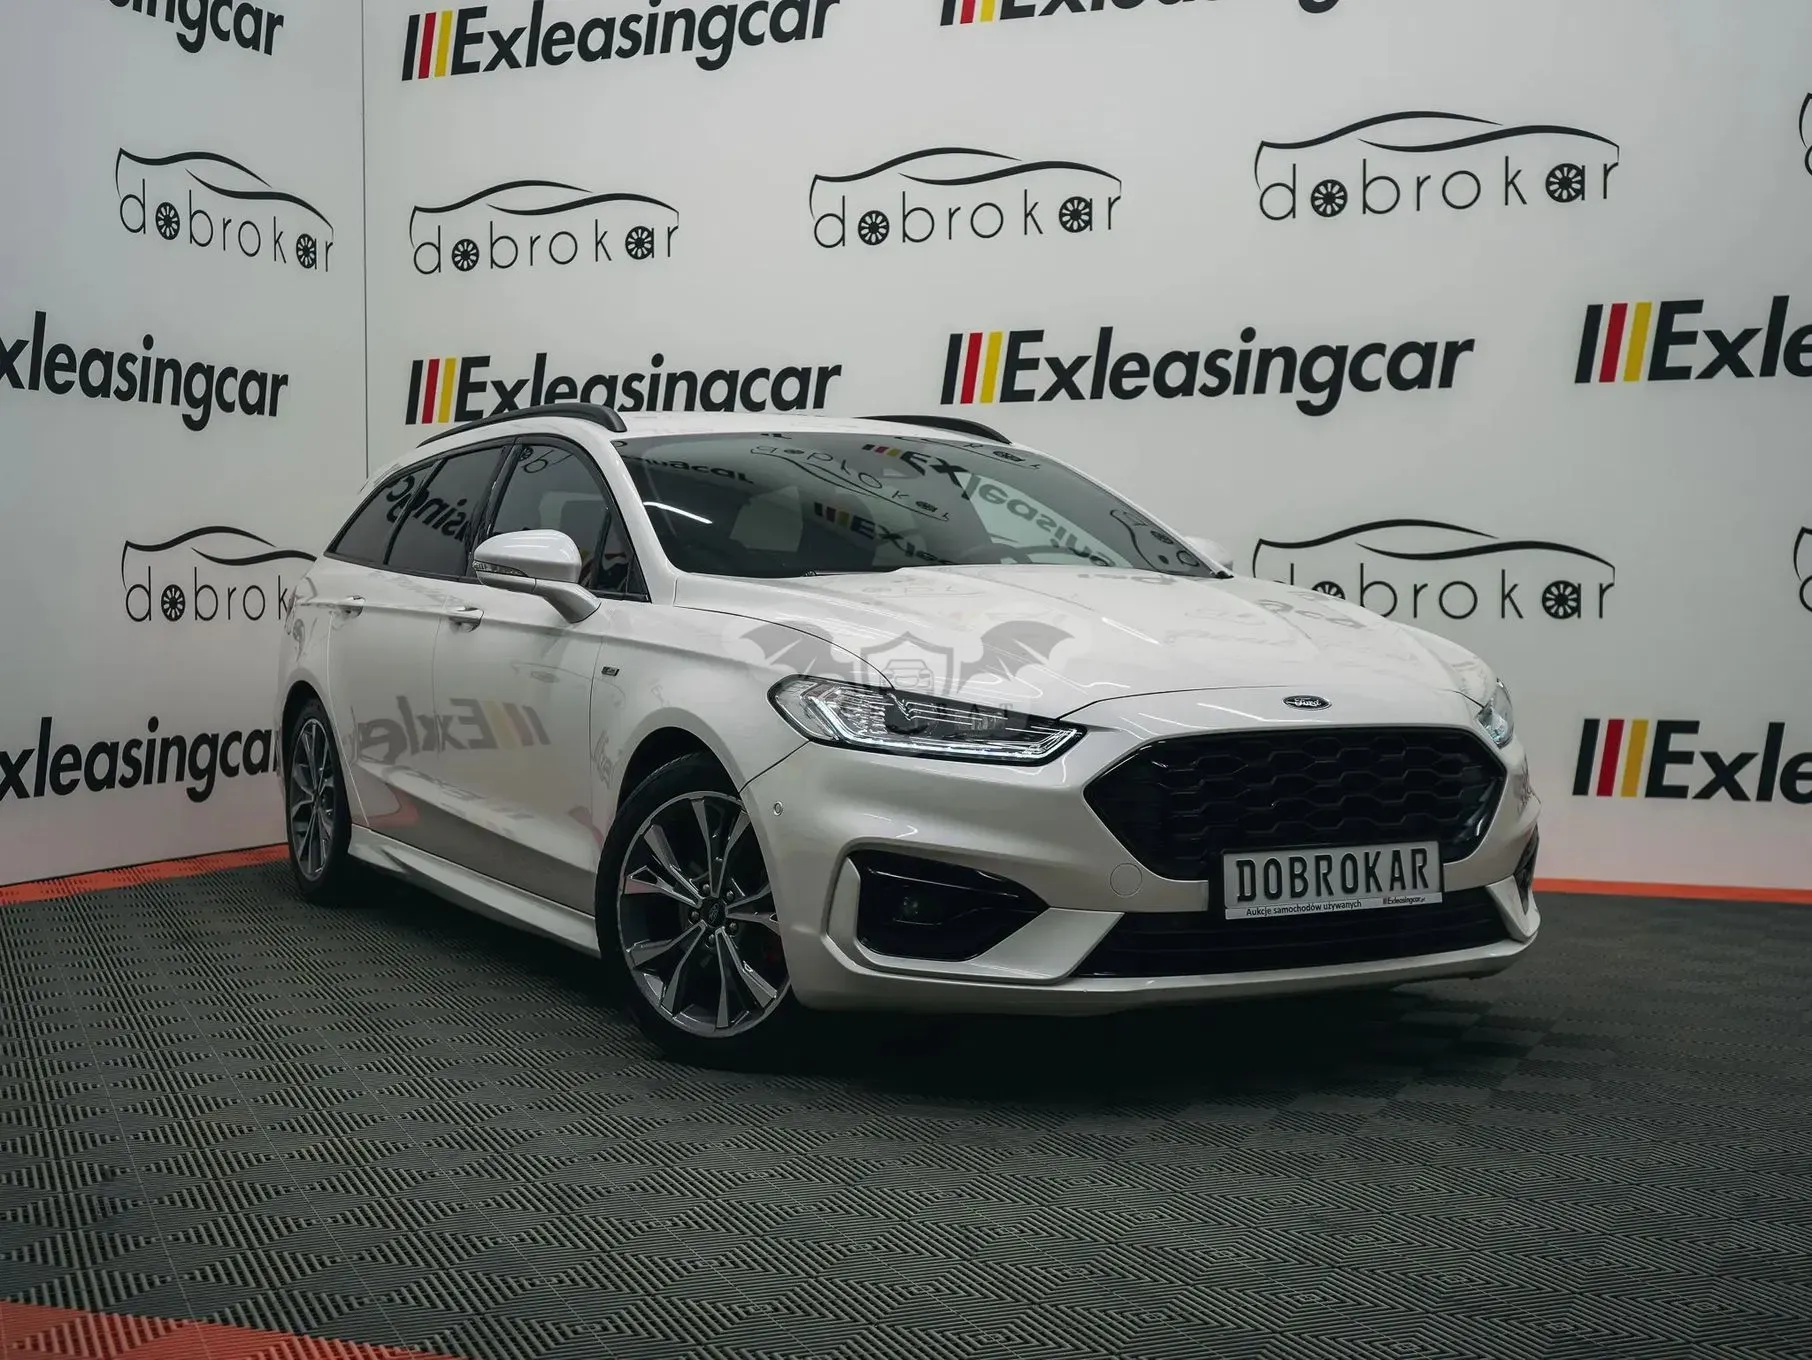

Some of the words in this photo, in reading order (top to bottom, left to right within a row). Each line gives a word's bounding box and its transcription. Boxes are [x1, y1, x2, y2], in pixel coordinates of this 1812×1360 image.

[451, 0, 840, 72] Exleasingcar
[812, 189, 1121, 249] dobrokar
[1258, 155, 1619, 221] dobrokar
[118, 178, 334, 272] dobrokar
[412, 214, 679, 275] dobrokar
[999, 326, 1475, 417] Exleasingcar
[1272, 562, 1616, 620] brokar
[0, 715, 276, 803] xleasingca
[1236, 848, 1429, 903] DOBROKAR
[1246, 906, 1272, 917] Aukcje
[1273, 903, 1322, 915] samochodów
[1323, 900, 1362, 911] używanych
